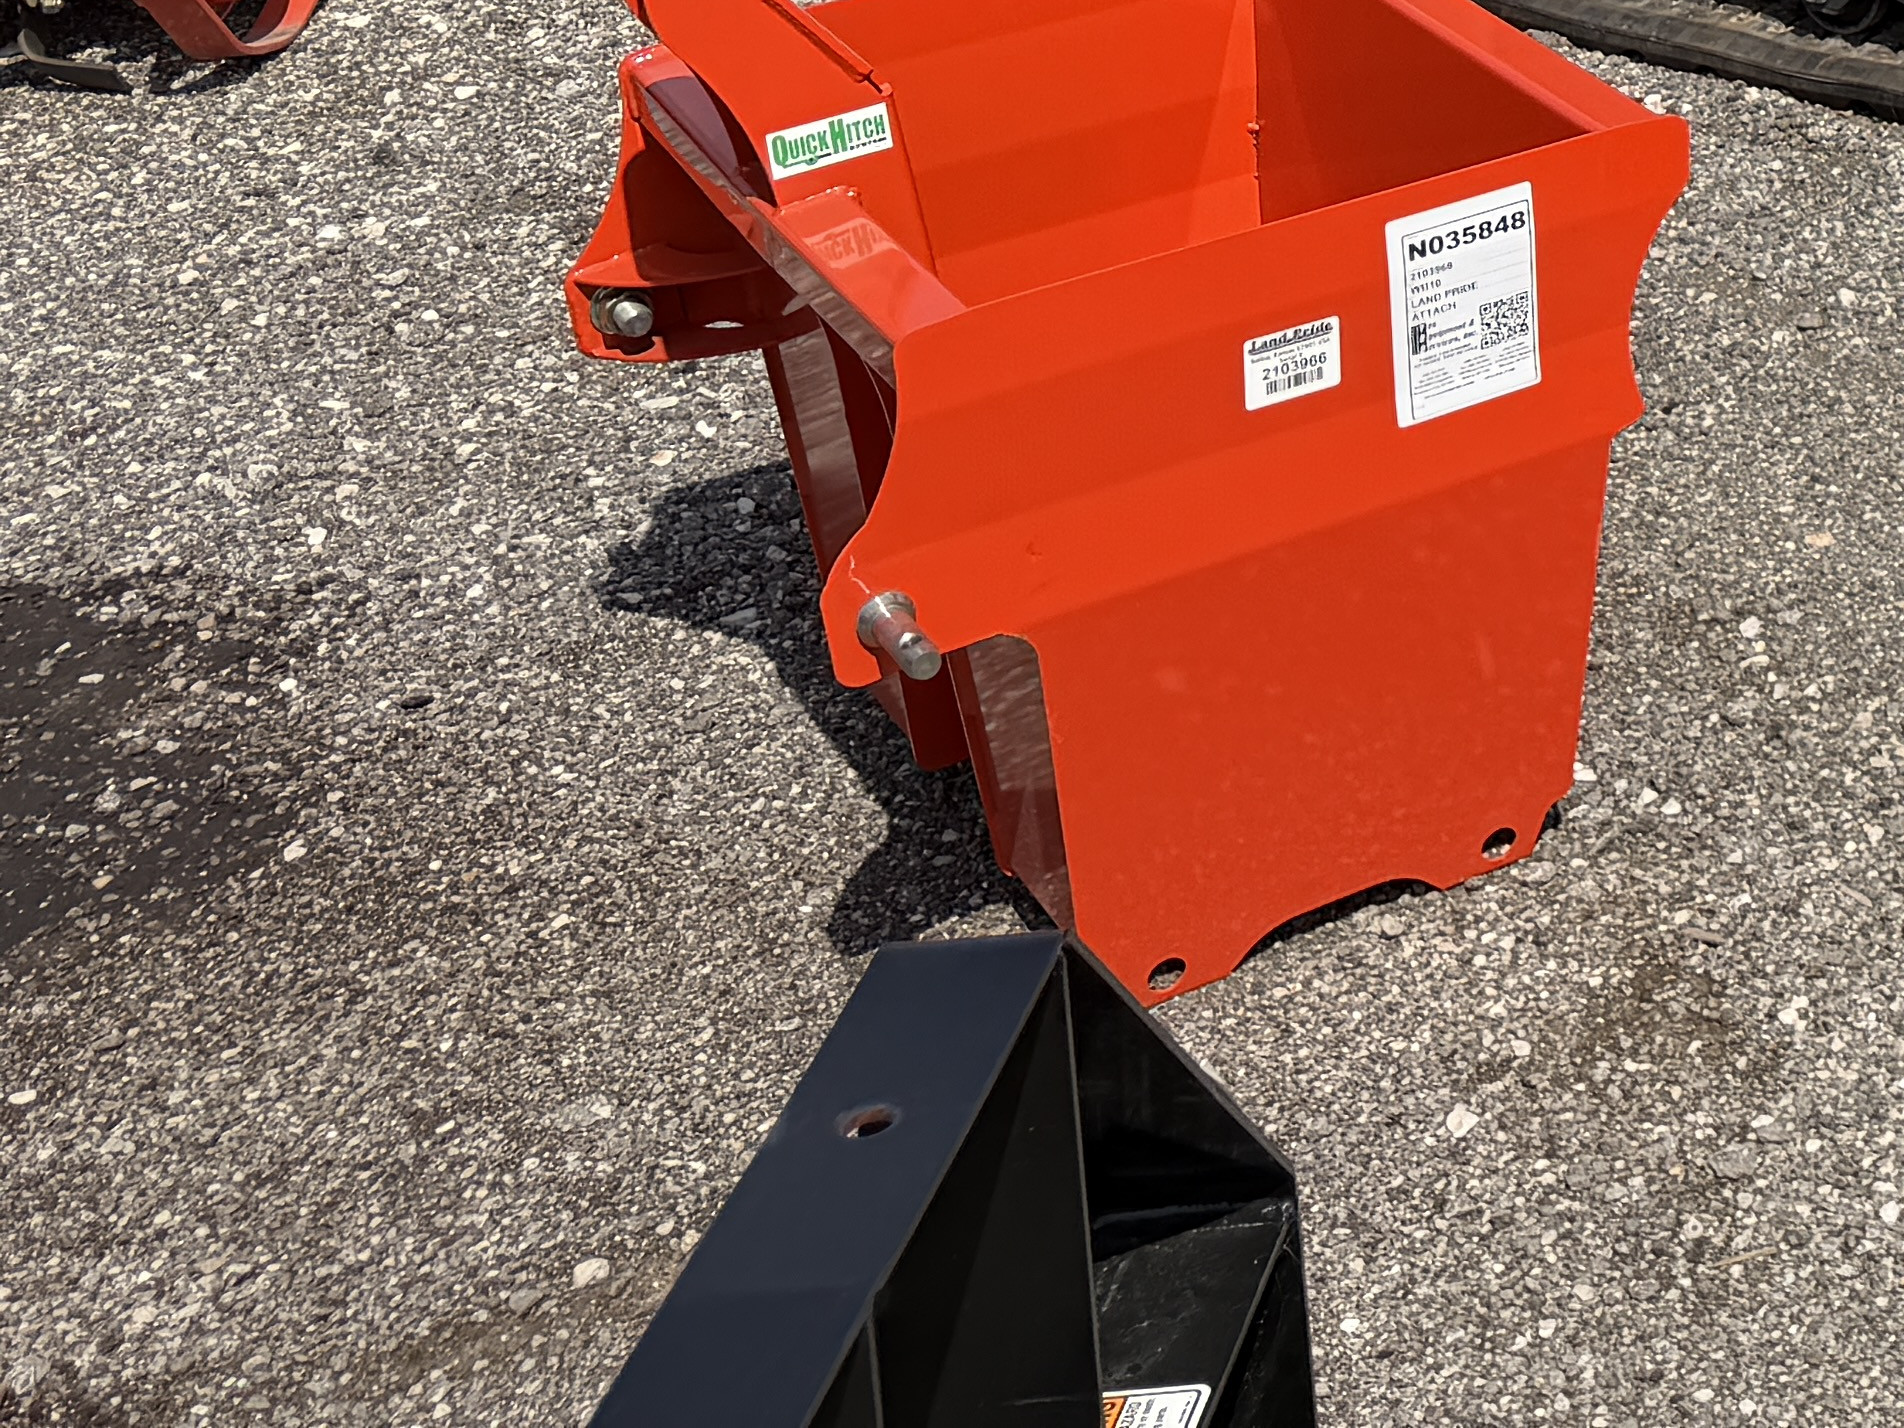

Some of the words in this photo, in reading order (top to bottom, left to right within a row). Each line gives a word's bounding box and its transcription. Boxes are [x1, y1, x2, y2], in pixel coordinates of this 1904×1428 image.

[1408, 211, 1526, 261] N035848
[1411, 293, 1441, 309] LAND
[1412, 301, 1457, 321] ATTACH
[1248, 332, 1287, 355] Land
